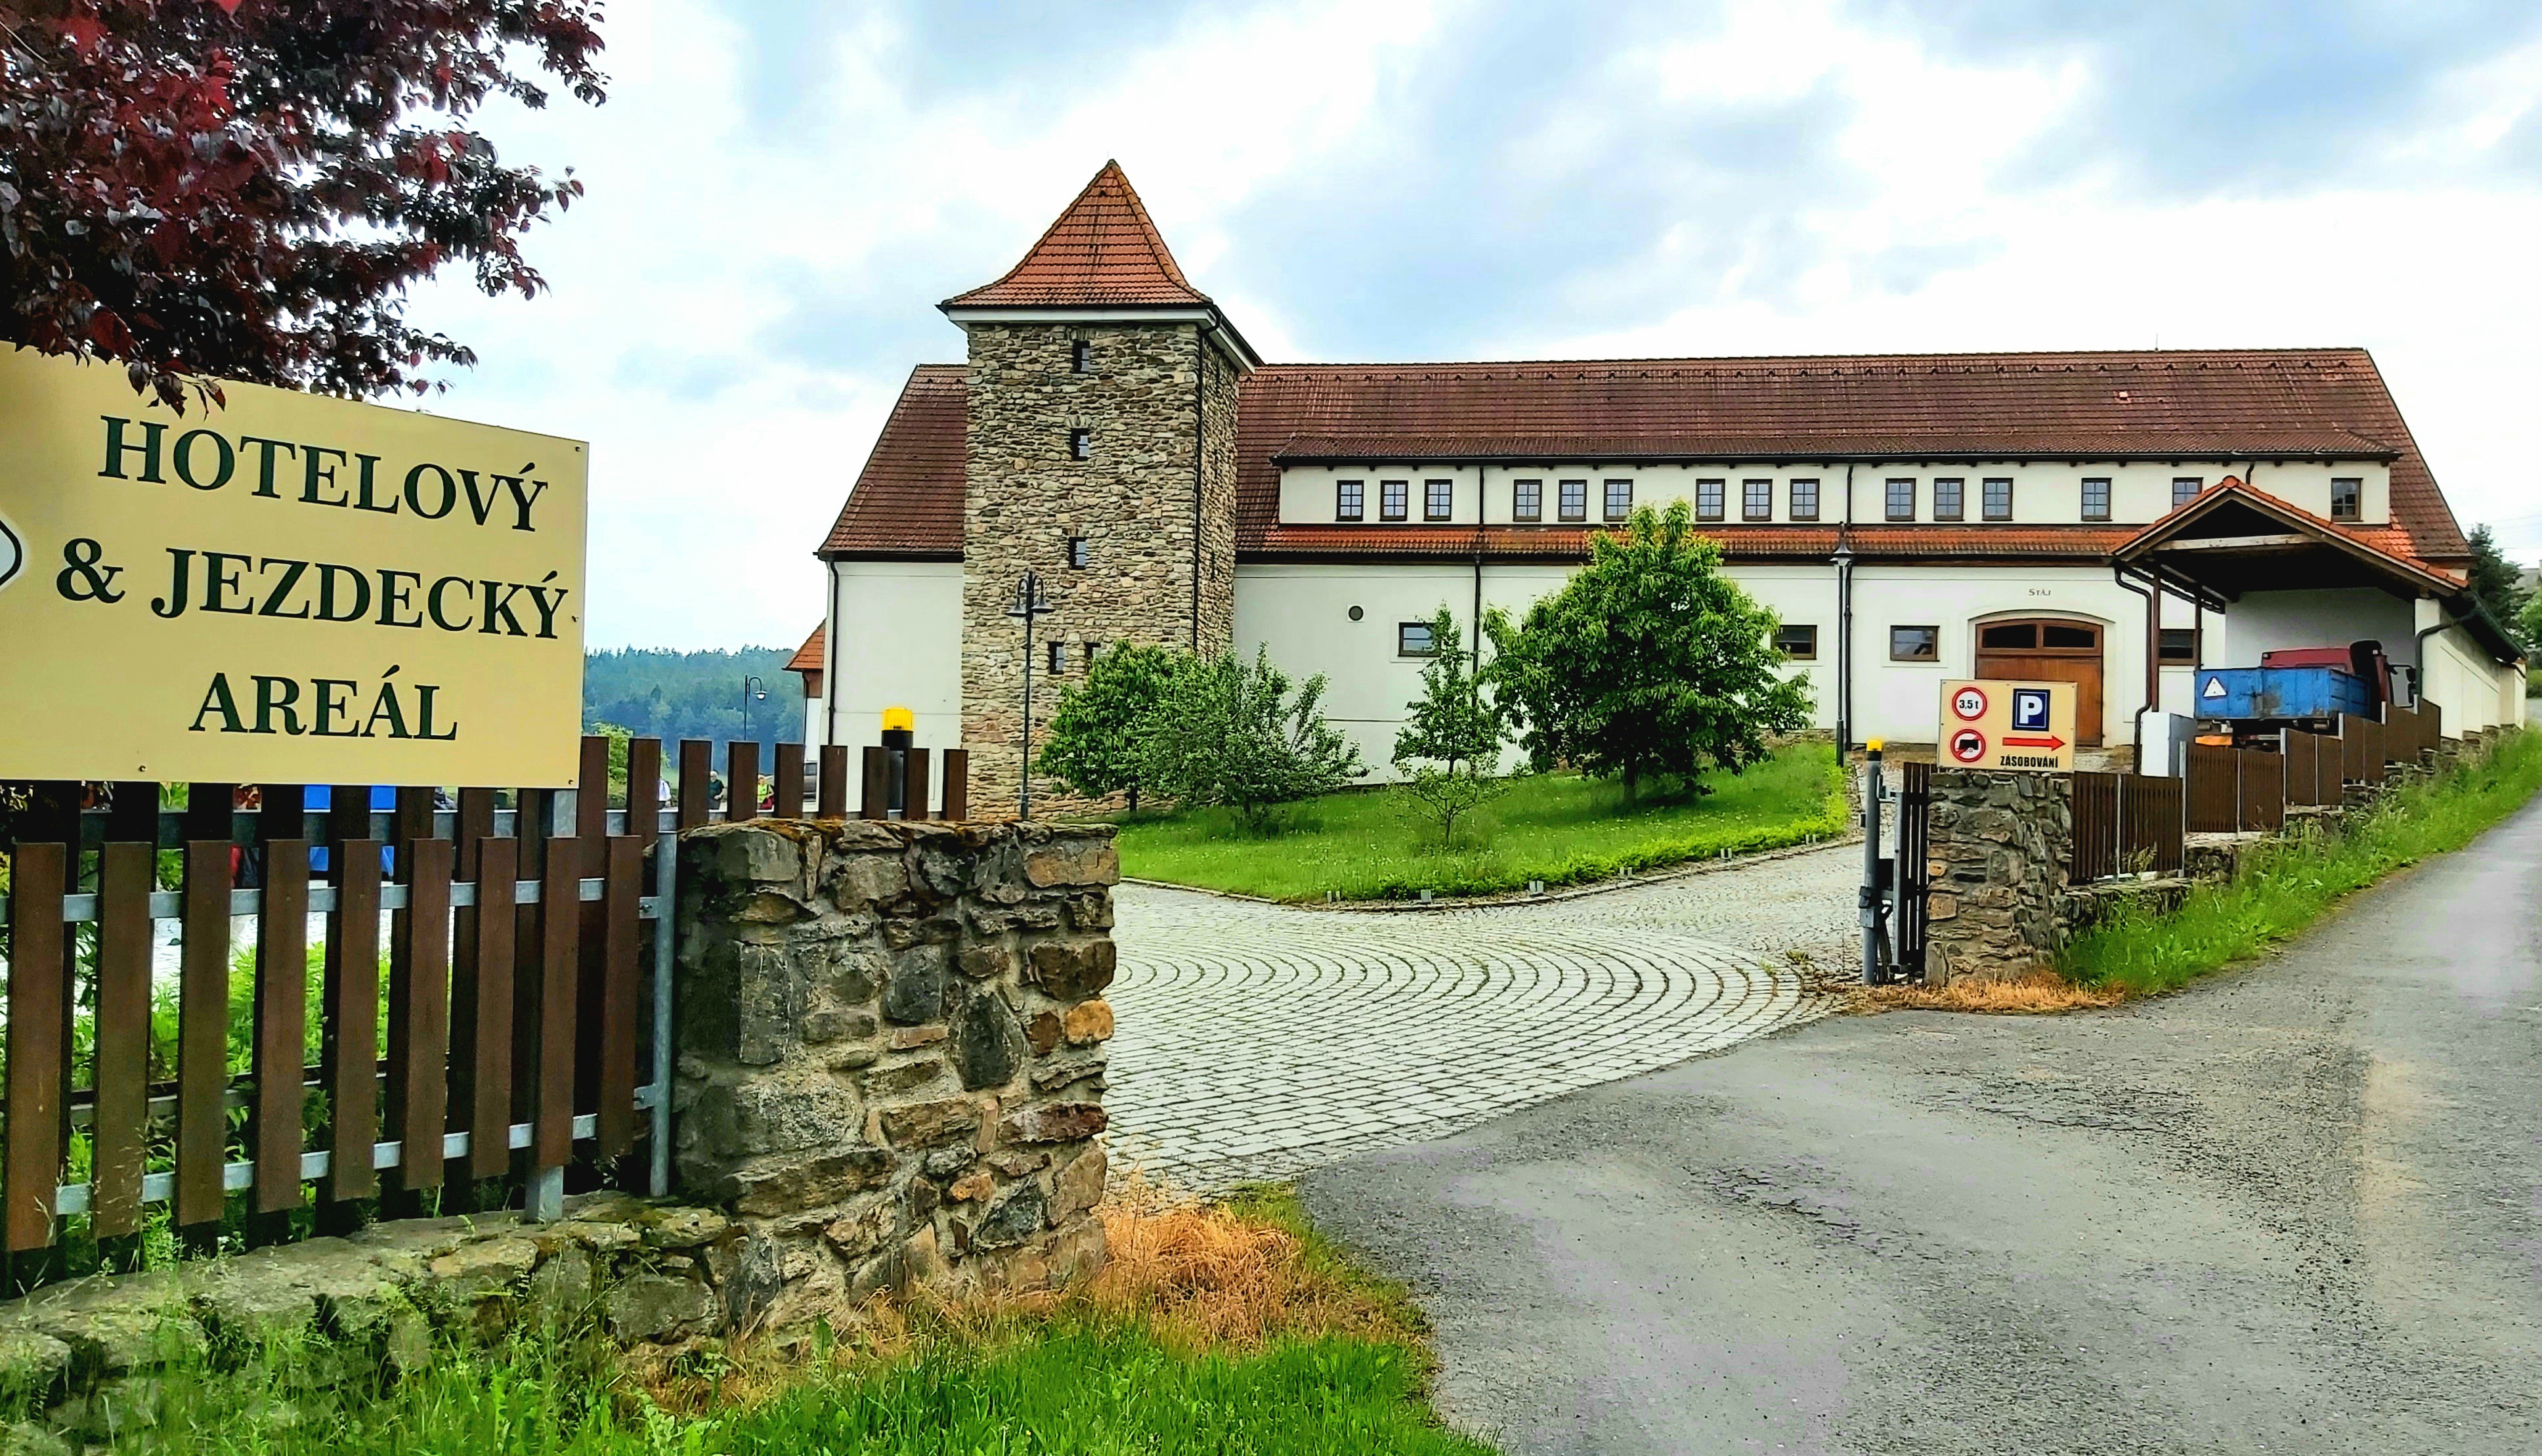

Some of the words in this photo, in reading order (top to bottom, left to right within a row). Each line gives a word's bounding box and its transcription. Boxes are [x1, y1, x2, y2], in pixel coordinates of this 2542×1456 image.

[97, 415, 548, 532] HOTELOVÝ
[56, 538, 126, 604] &
[151, 547, 569, 639] JEZDECKÝ
[188, 664, 458, 741] AREÁL
[2019, 695, 2043, 724] P
[2000, 754, 2058, 768] ZÁSOBOVÁNÍ
